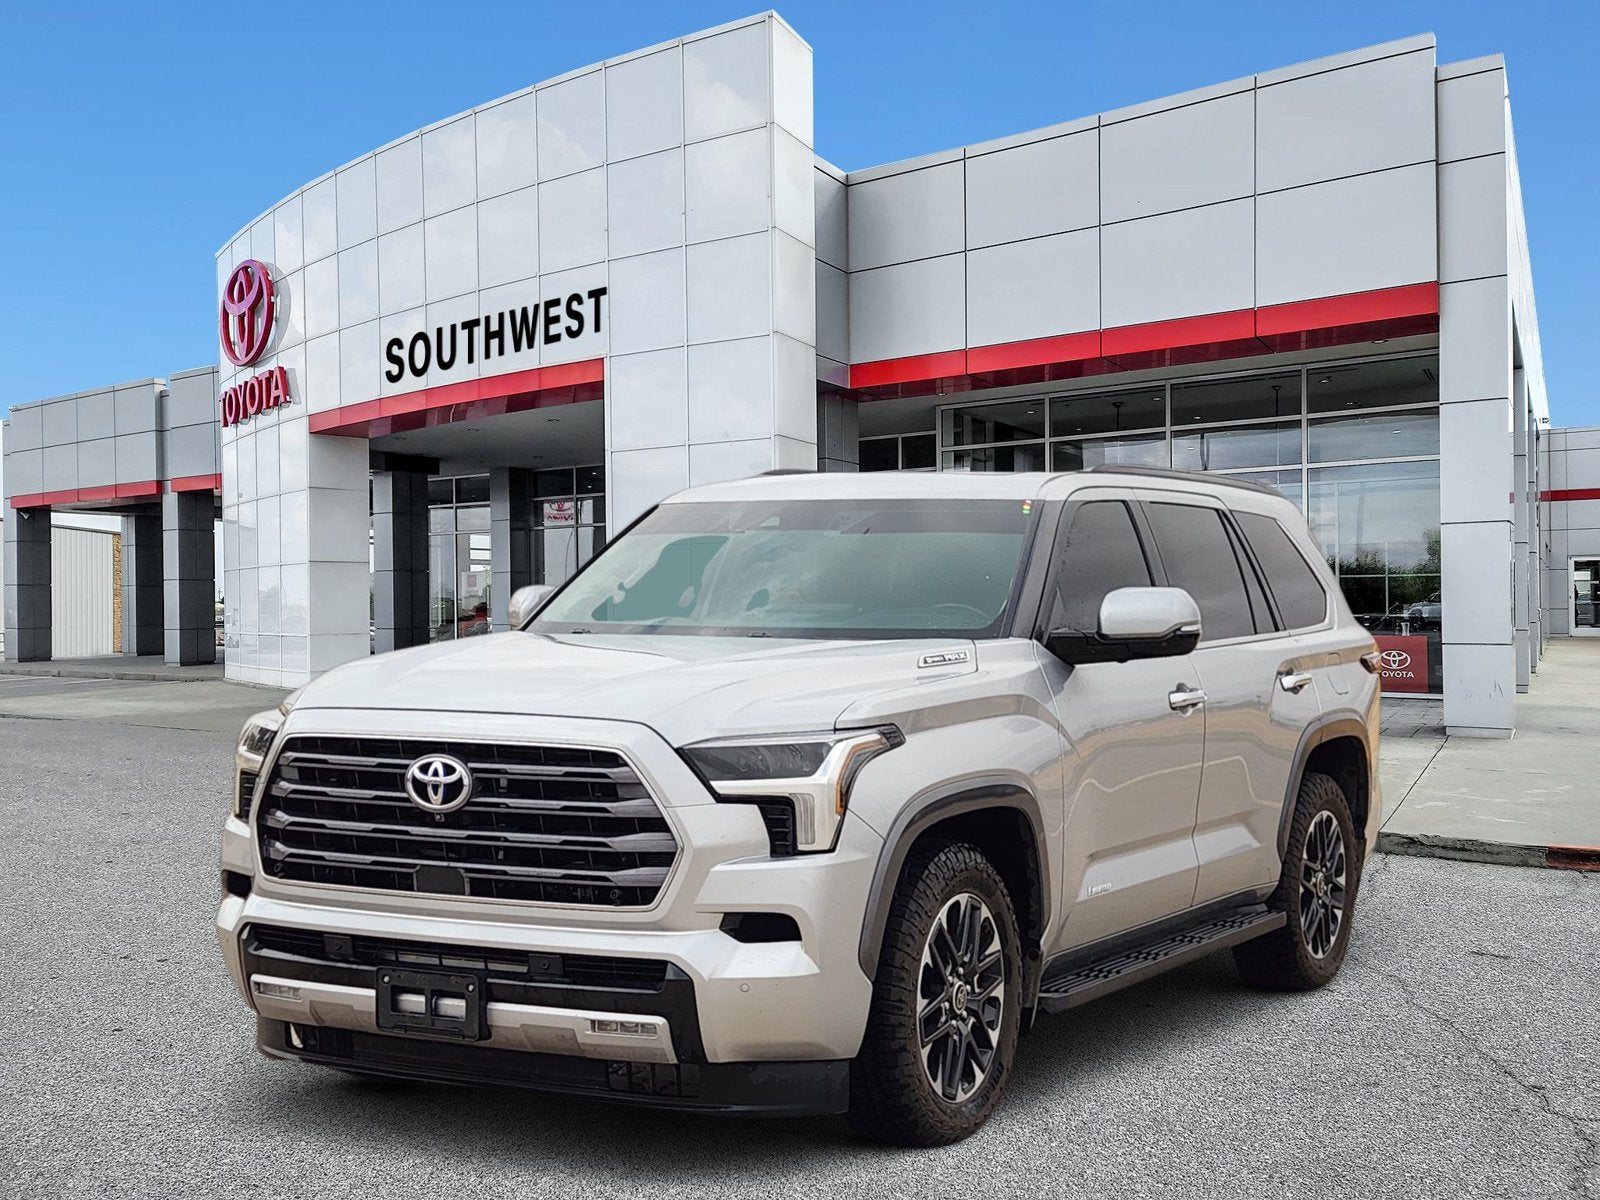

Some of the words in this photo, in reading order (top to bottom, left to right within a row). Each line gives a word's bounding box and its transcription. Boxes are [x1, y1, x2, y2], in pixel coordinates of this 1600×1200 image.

[385, 286, 608, 384] SOUTHWEST
[217, 366, 290, 428] TOYOTA
[1381, 670, 1415, 678] OYOTA
